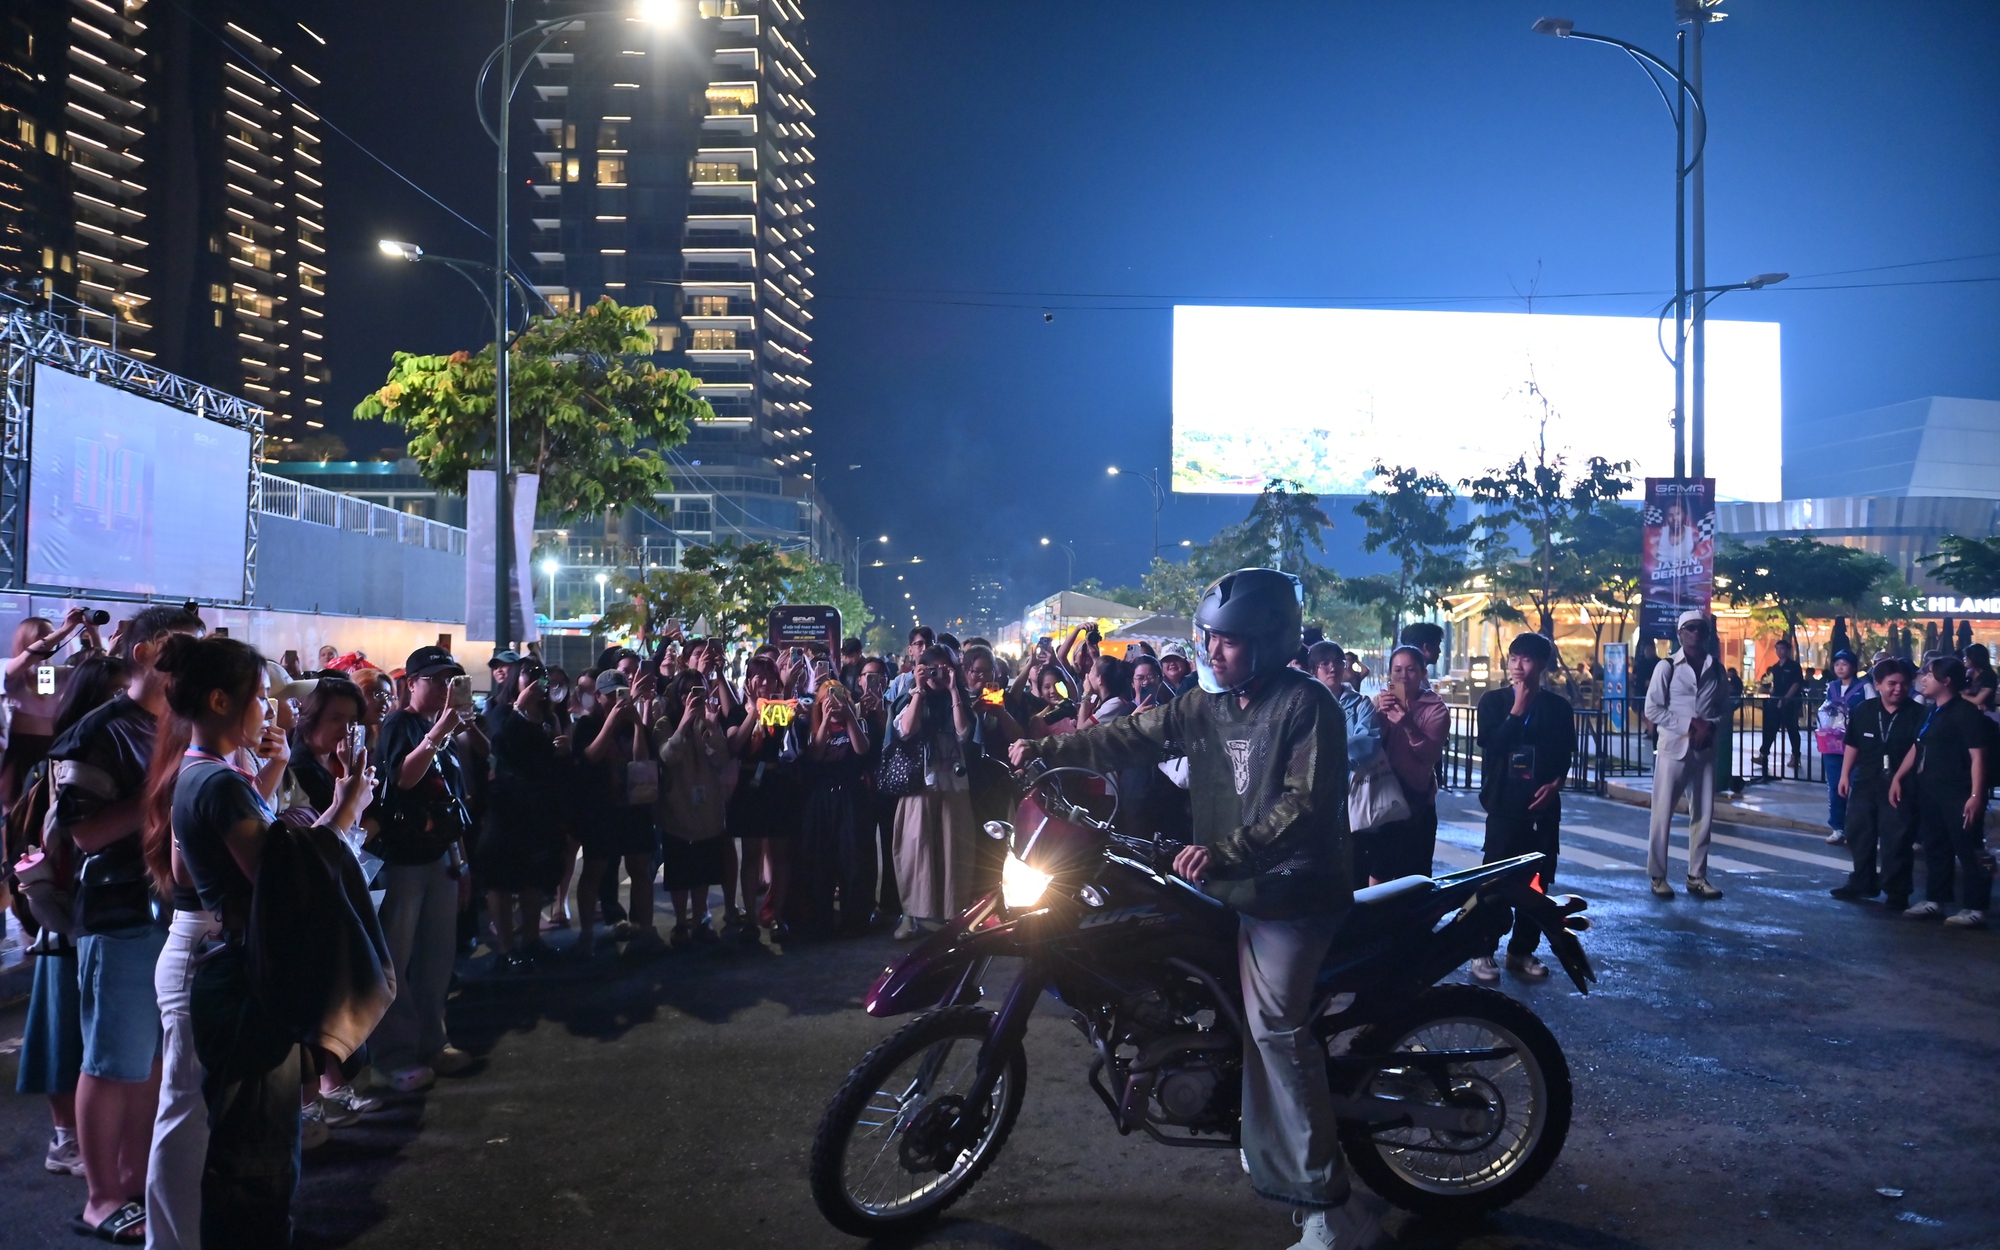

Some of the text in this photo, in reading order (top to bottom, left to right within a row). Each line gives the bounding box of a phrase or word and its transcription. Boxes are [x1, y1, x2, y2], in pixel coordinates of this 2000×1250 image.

[1655, 484, 1705, 493] GAMA
[1654, 557, 1699, 570] JASON
[1651, 565, 1703, 580] DERULO
[760, 704, 791, 726] KAY
